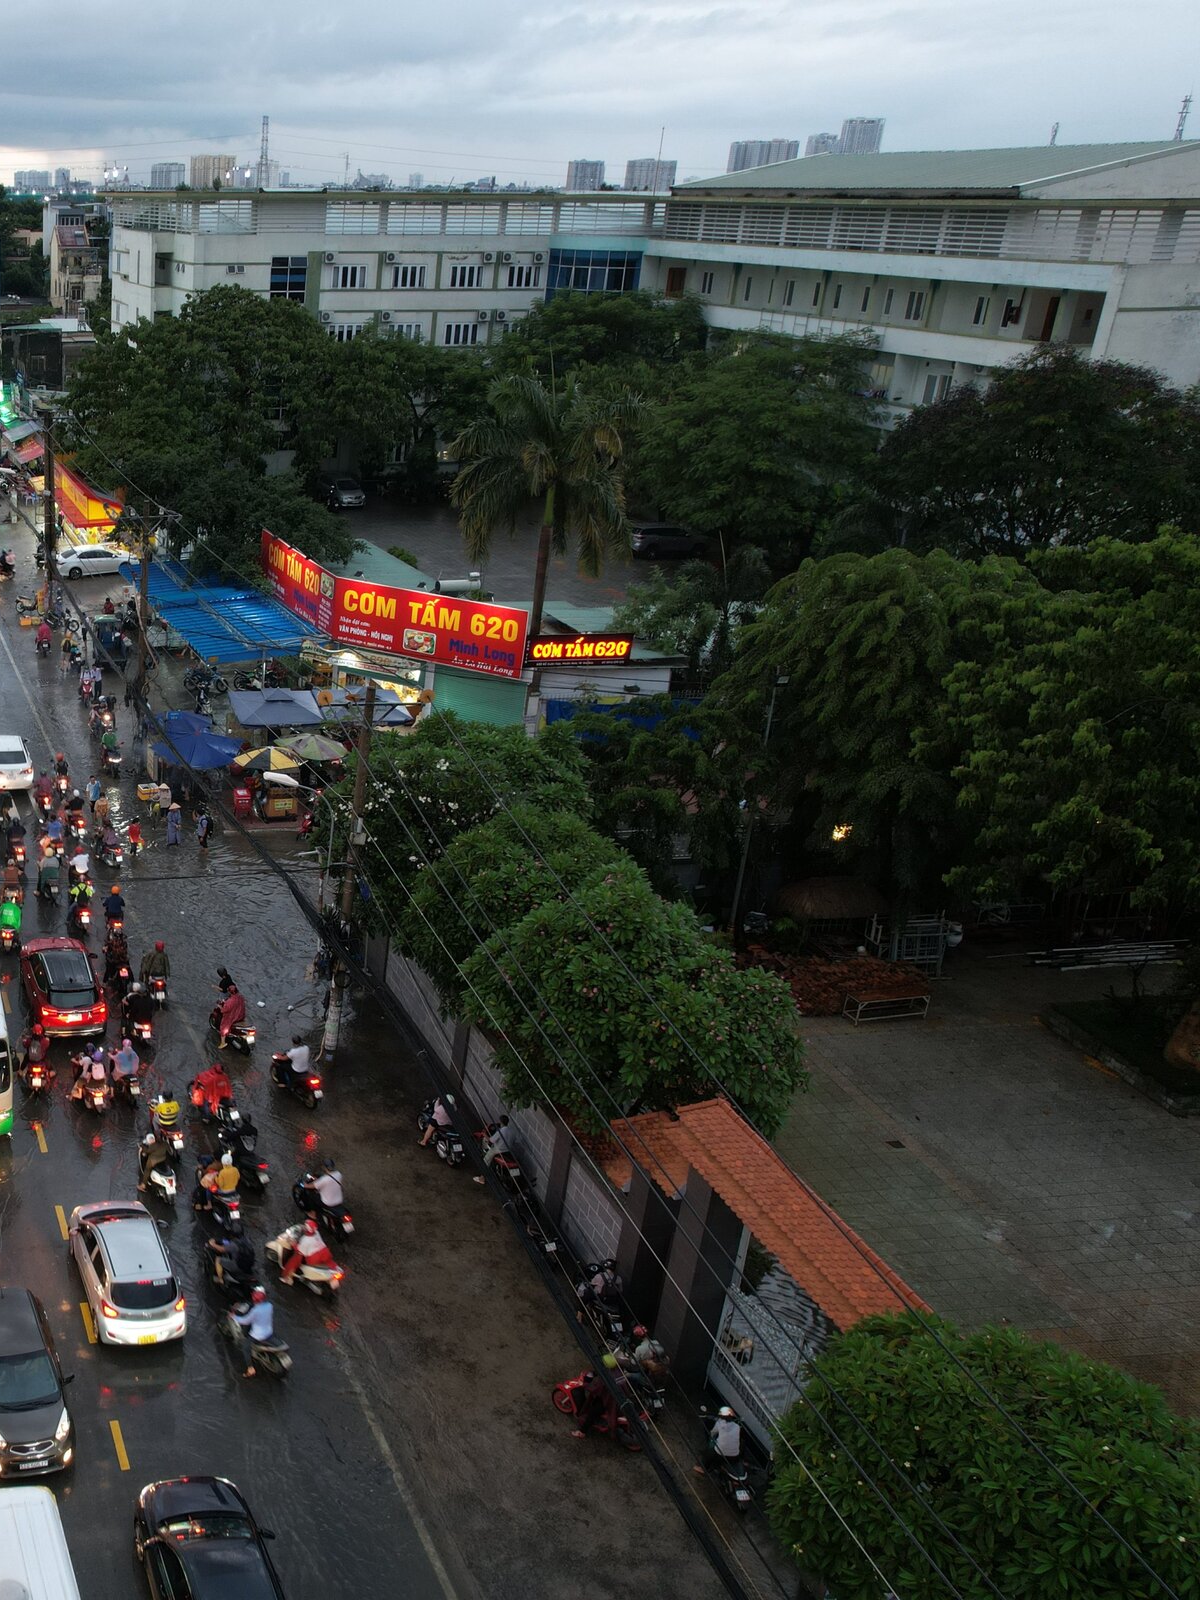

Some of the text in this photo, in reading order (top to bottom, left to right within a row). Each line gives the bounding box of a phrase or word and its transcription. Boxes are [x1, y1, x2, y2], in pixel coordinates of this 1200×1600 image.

[269, 543, 320, 596] CƠM TẤM 620
[344, 590, 397, 619] CƠM
[409, 599, 461, 632] TẤM
[470, 614, 518, 642] 620
[449, 638, 516, 667] Minh Long
[533, 637, 629, 658] CƠM TẤM 620
